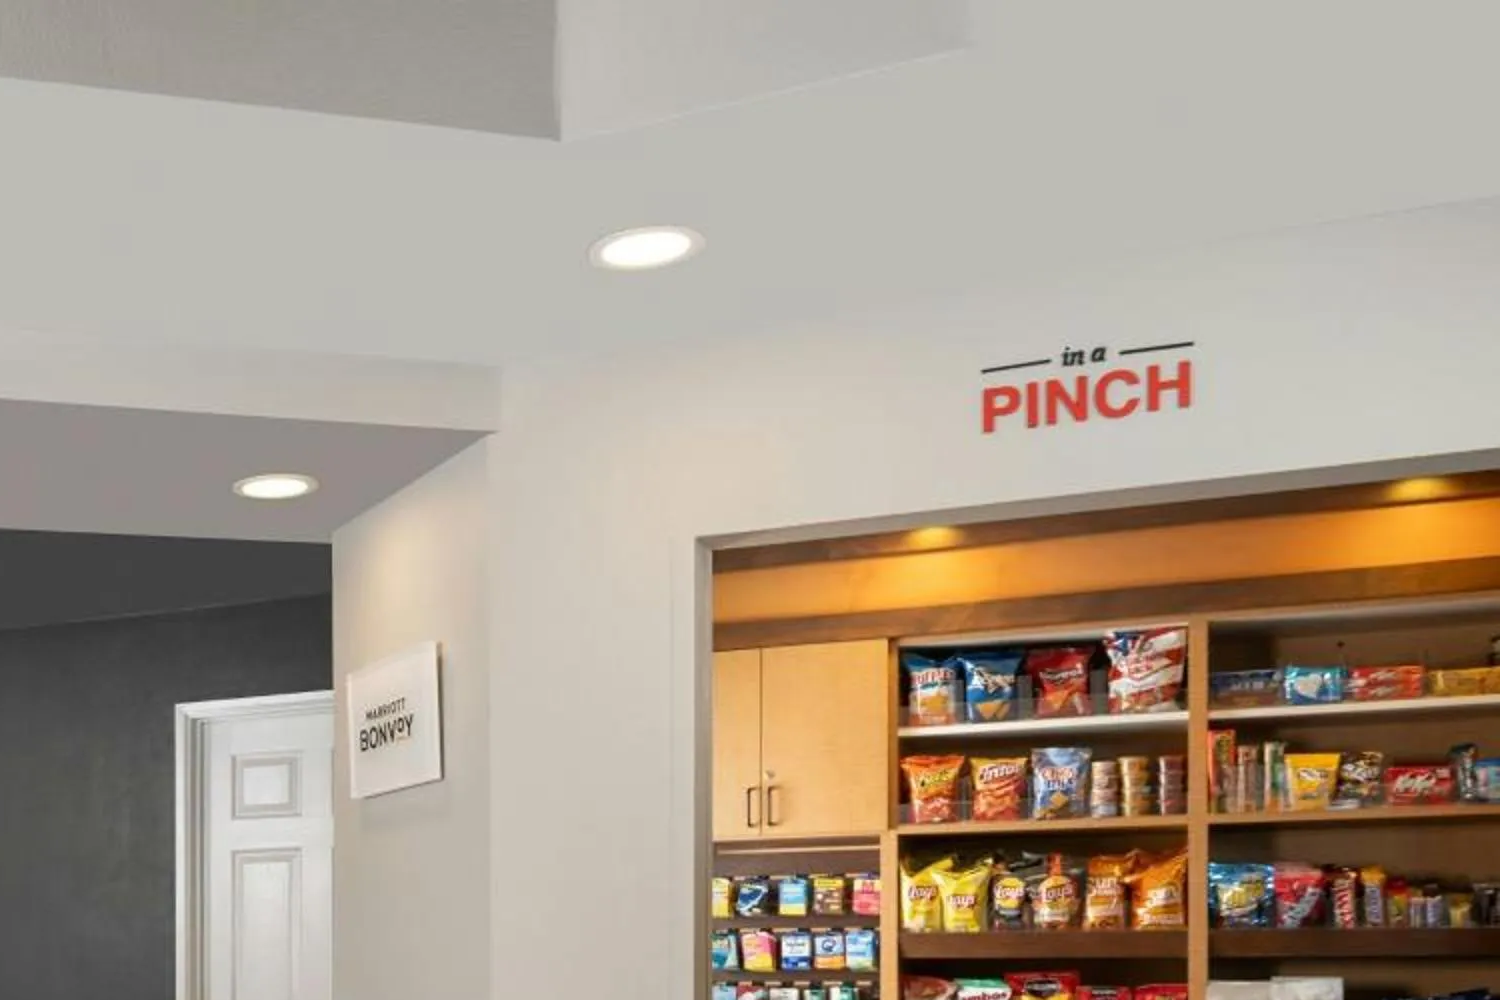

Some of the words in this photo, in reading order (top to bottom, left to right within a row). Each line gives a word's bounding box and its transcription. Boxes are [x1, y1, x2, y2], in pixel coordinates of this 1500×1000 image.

[1061, 346, 1085, 367] in
[1090, 346, 1107, 363] a
[981, 359, 1192, 435] PINCH
[365, 697, 406, 721] MARRIOTT
[359, 713, 415, 752] BONVOY
